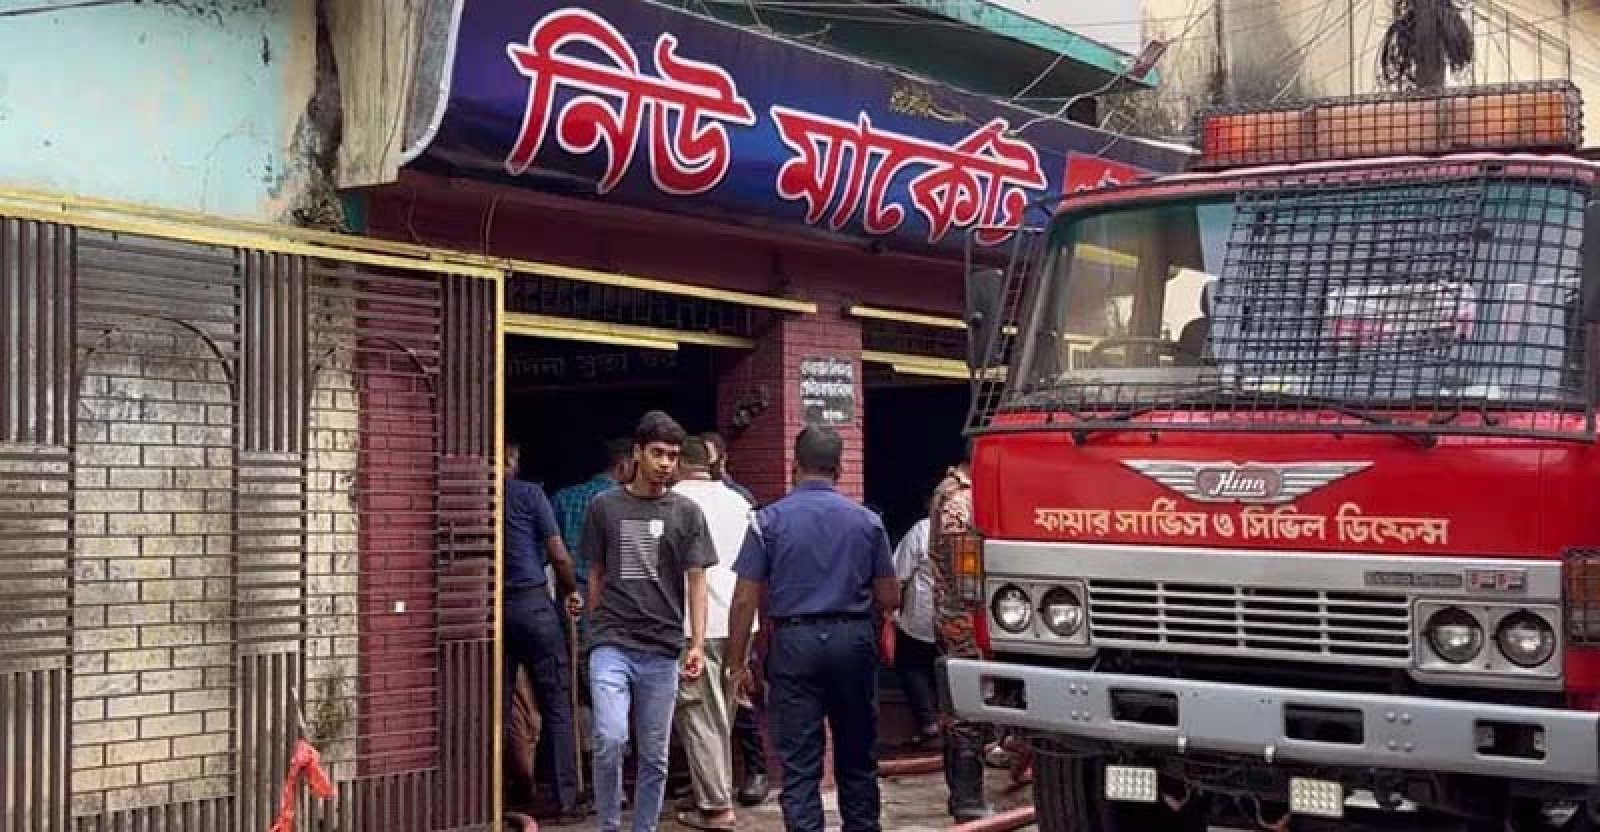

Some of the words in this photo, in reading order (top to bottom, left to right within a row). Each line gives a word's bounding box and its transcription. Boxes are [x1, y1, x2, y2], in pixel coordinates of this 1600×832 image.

[507, 8, 754, 193] নিউ
[770, 111, 1047, 244] মার্কেট
[1034, 507, 1110, 536] ফায়ার
[1115, 497, 1207, 537] সার্ভিস
[1213, 513, 1235, 537] ও
[1240, 505, 1327, 541] সিভিল
[1335, 501, 1450, 545] ডিফেন্স
